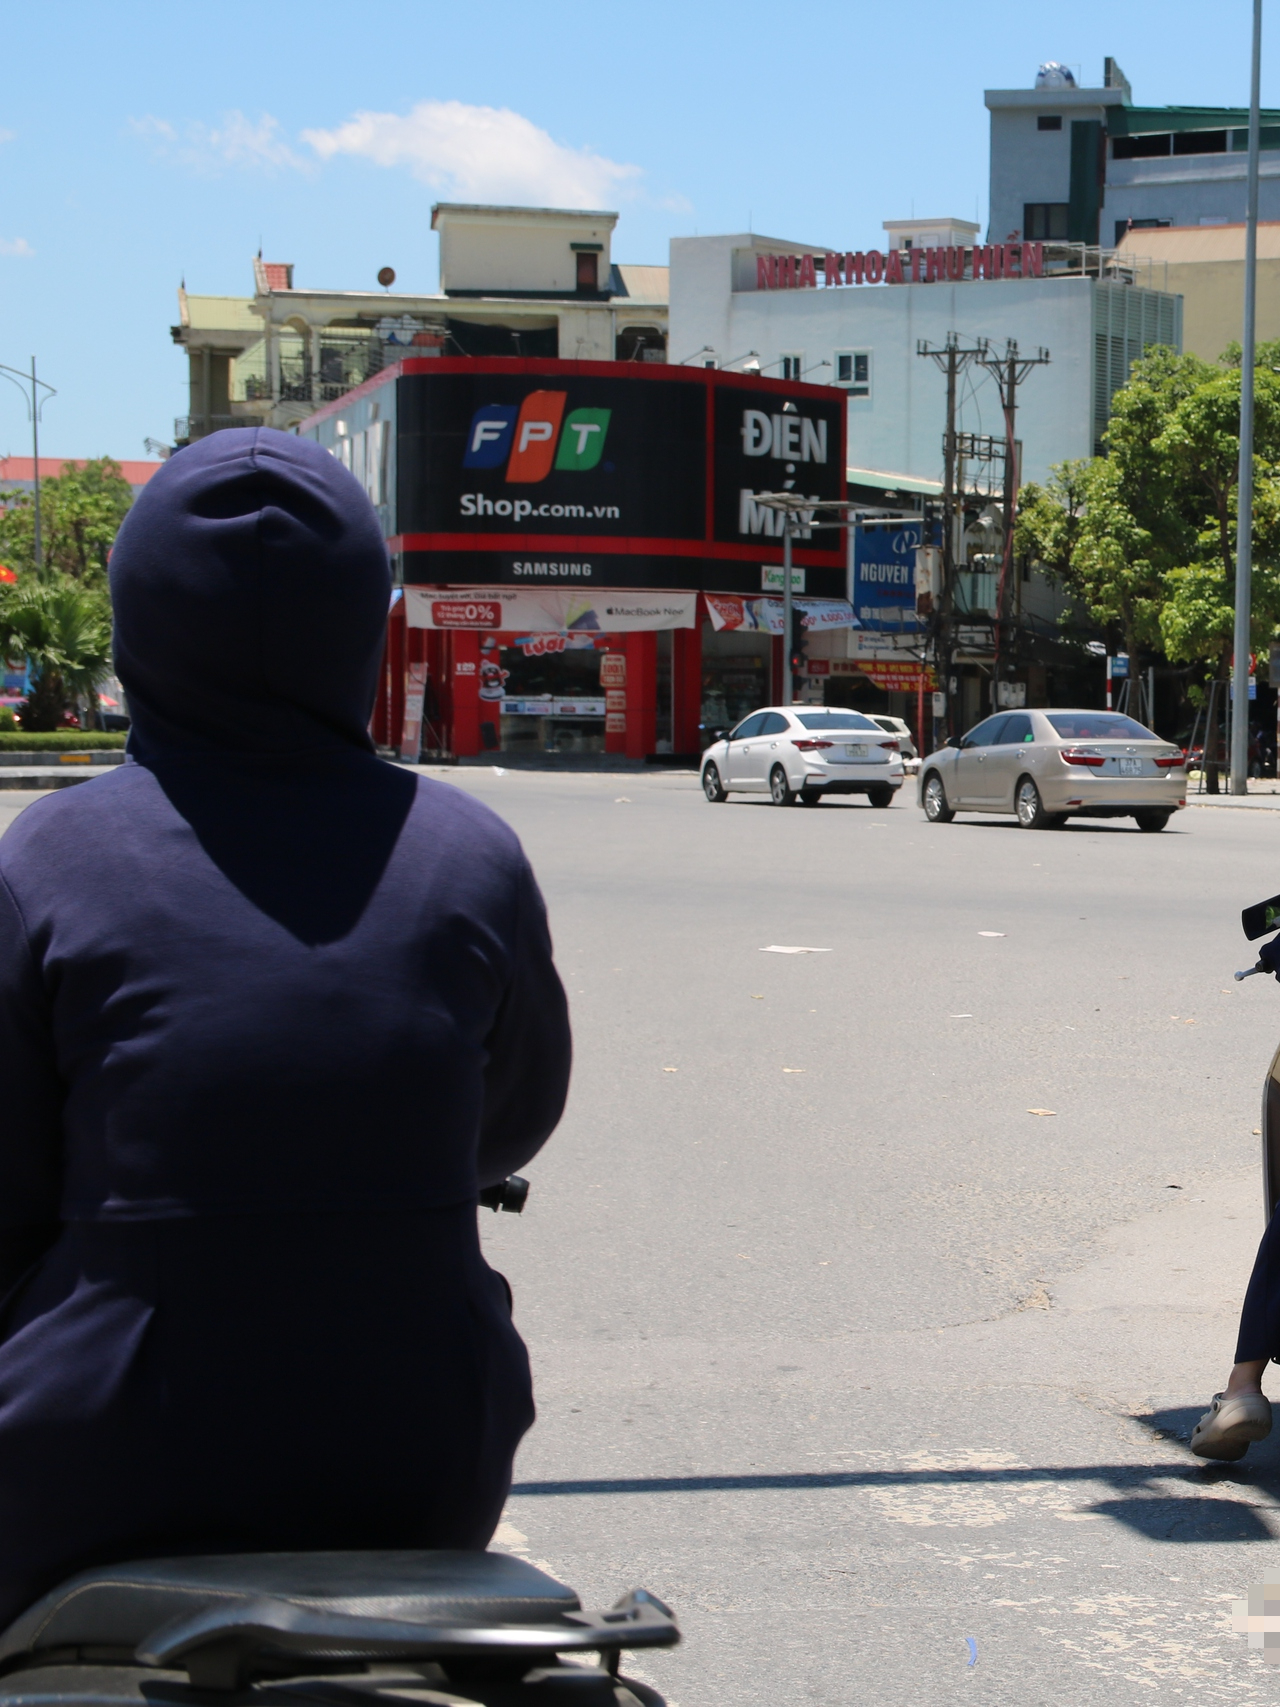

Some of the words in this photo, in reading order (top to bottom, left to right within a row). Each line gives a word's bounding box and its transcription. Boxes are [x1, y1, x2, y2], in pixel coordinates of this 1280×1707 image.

[756, 252, 817, 290] NHA
[825, 249, 905, 286] KHOA
[908, 246, 964, 283] THU
[740, 401, 828, 473] ĐIỆN
[460, 493, 620, 522] Shop.com.vn
[513, 562, 592, 576] SAMSUNG
[764, 569, 801, 586] Kangoo
[465, 604, 495, 620] 0%
[614, 607, 662, 616] MacBook
